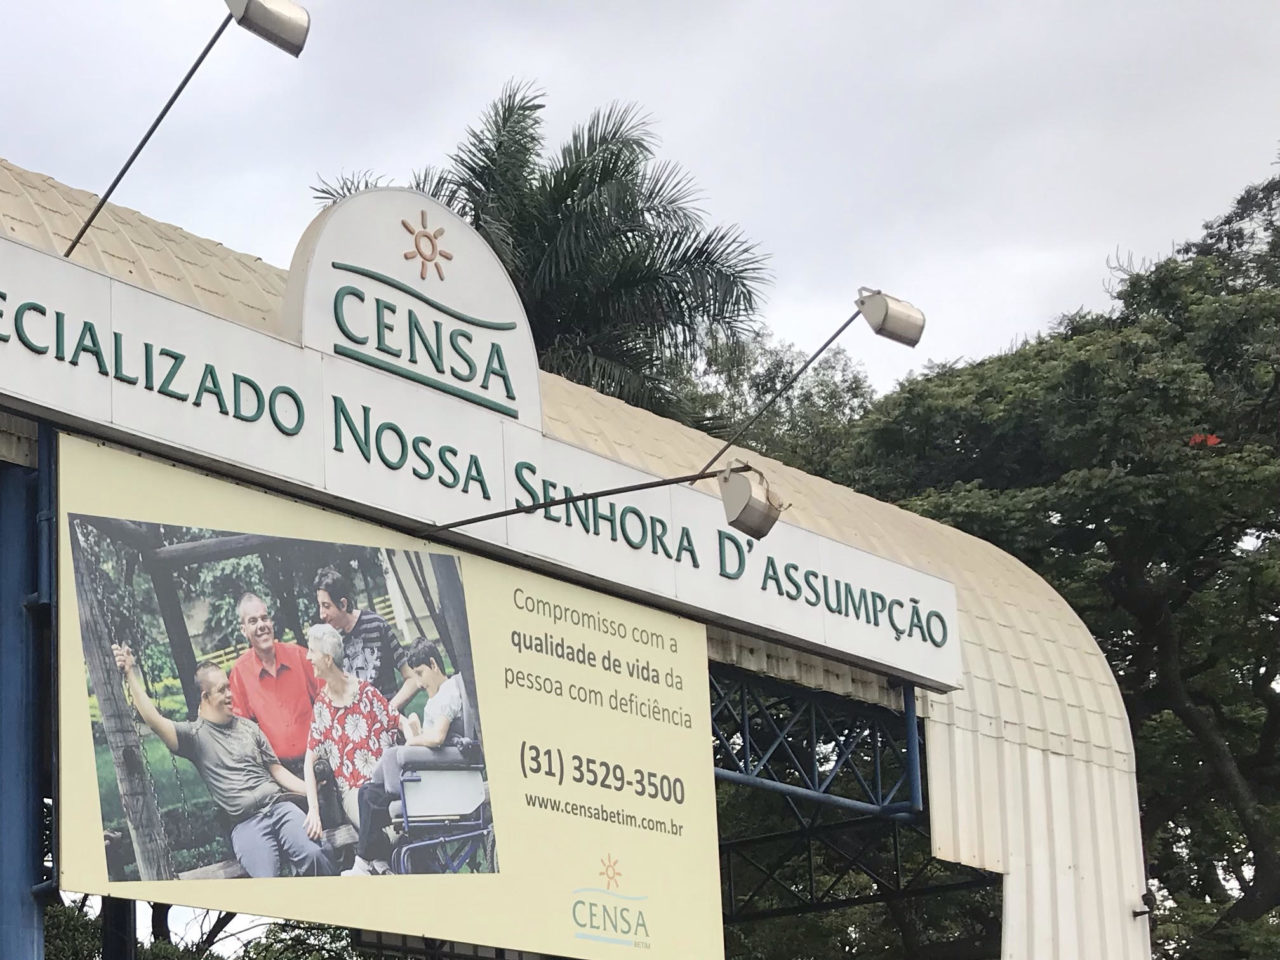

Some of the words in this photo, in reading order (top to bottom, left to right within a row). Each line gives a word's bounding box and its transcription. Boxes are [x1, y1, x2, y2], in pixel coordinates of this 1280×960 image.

[334, 286, 516, 400] CENSA
[331, 395, 491, 500] NOSSA
[514, 461, 699, 568] SENHORA
[513, 587, 627, 639] Compromisso
[632, 625, 665, 650] com
[669, 637, 678, 653] a
[511, 629, 596, 667] qualidade
[601, 650, 622, 674] de
[626, 658, 660, 685] vida
[664, 667, 683, 690] da
[504, 665, 563, 696] pessoa
[569, 683, 603, 707] com
[609, 690, 693, 729] deficiência
[520, 740, 564, 786] (31)
[571, 754, 685, 805] 3529-3500
[525, 792, 684, 837] www.censabetim.com.br
[572, 899, 650, 938] CENSA
